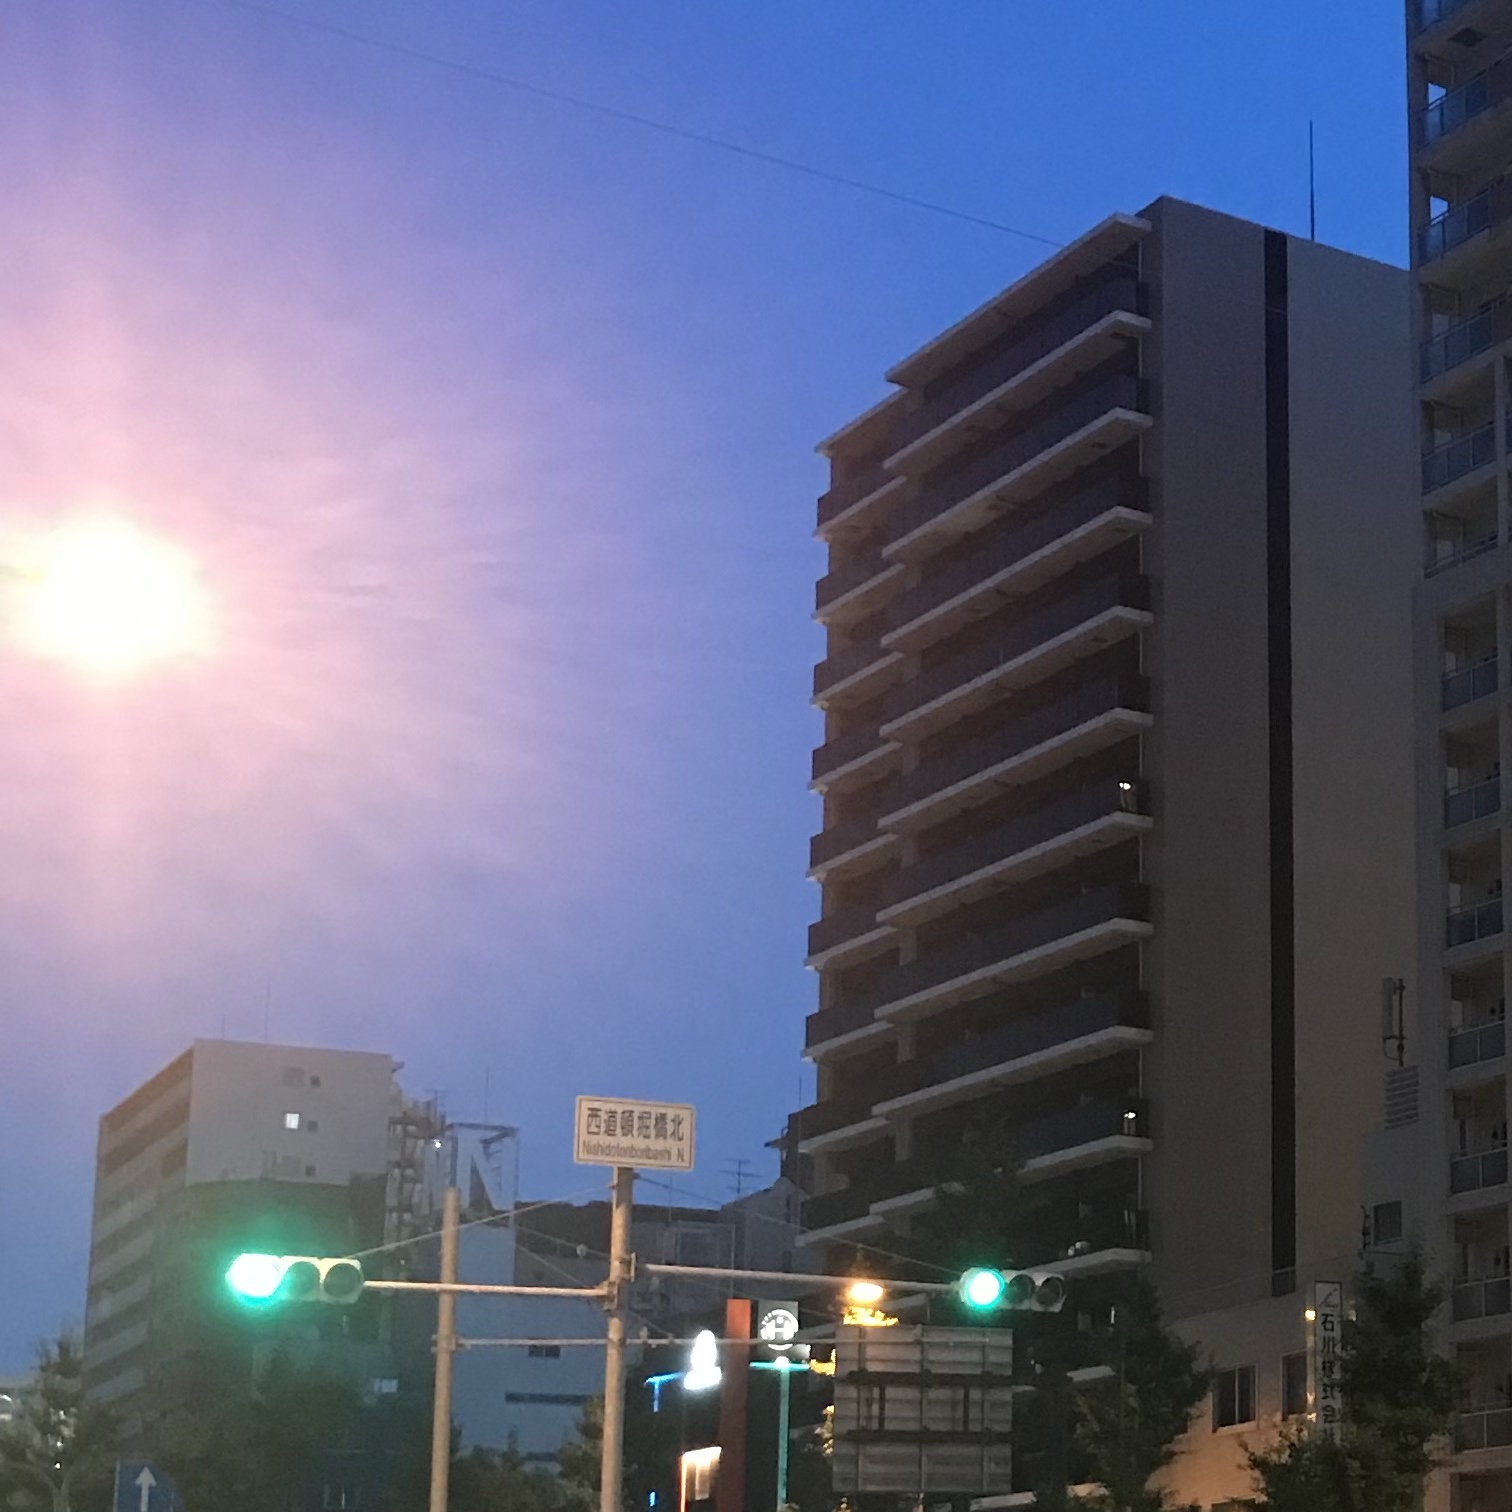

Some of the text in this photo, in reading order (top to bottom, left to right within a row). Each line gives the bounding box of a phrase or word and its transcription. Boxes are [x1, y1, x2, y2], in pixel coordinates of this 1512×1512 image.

[586, 1106, 685, 1142] 西道頓堀橋北
[676, 1147, 686, 1162] N
